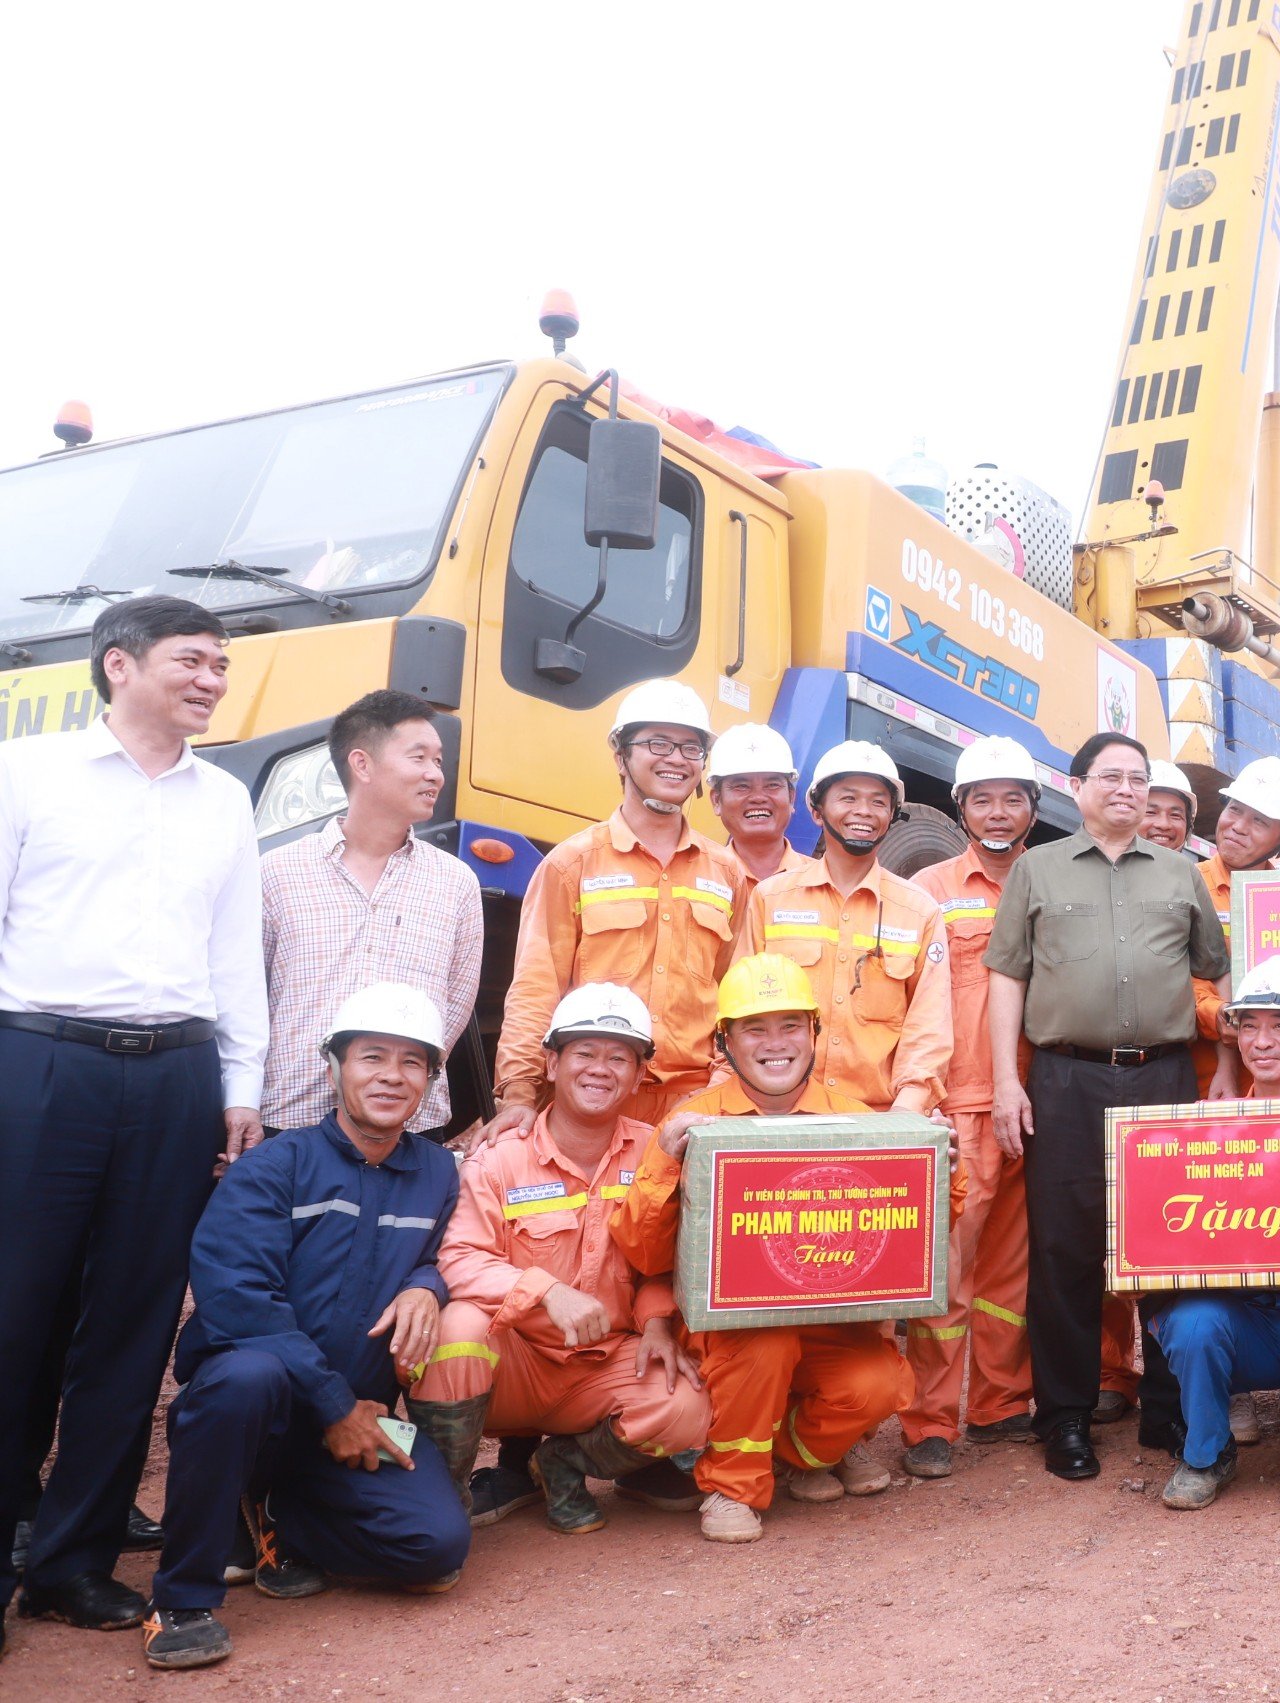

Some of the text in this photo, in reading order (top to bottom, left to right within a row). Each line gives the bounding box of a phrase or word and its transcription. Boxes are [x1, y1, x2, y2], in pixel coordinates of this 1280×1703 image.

[901, 538, 1044, 661] 0942 103 368
[890, 603, 1040, 721] XCT300
[1136, 1138, 1162, 1158] TỈNH
[1185, 1160, 1264, 1181] TỈNH NGHỆ AN
[743, 1186, 754, 1202] ỦY
[755, 1188, 773, 1201] VIÊN
[774, 1189, 786, 1203] BỘ
[786, 1187, 811, 1201] CHÍNH
[828, 1185, 843, 1200] THỦ
[843, 1187, 868, 1199] TƯỚNG
[869, 1185, 892, 1198] CHÍNH
[893, 1183, 908, 1197] PHỦ
[731, 1203, 919, 1240] PHẠM MINH CHÍNH
[794, 1244, 856, 1268] Tặng
